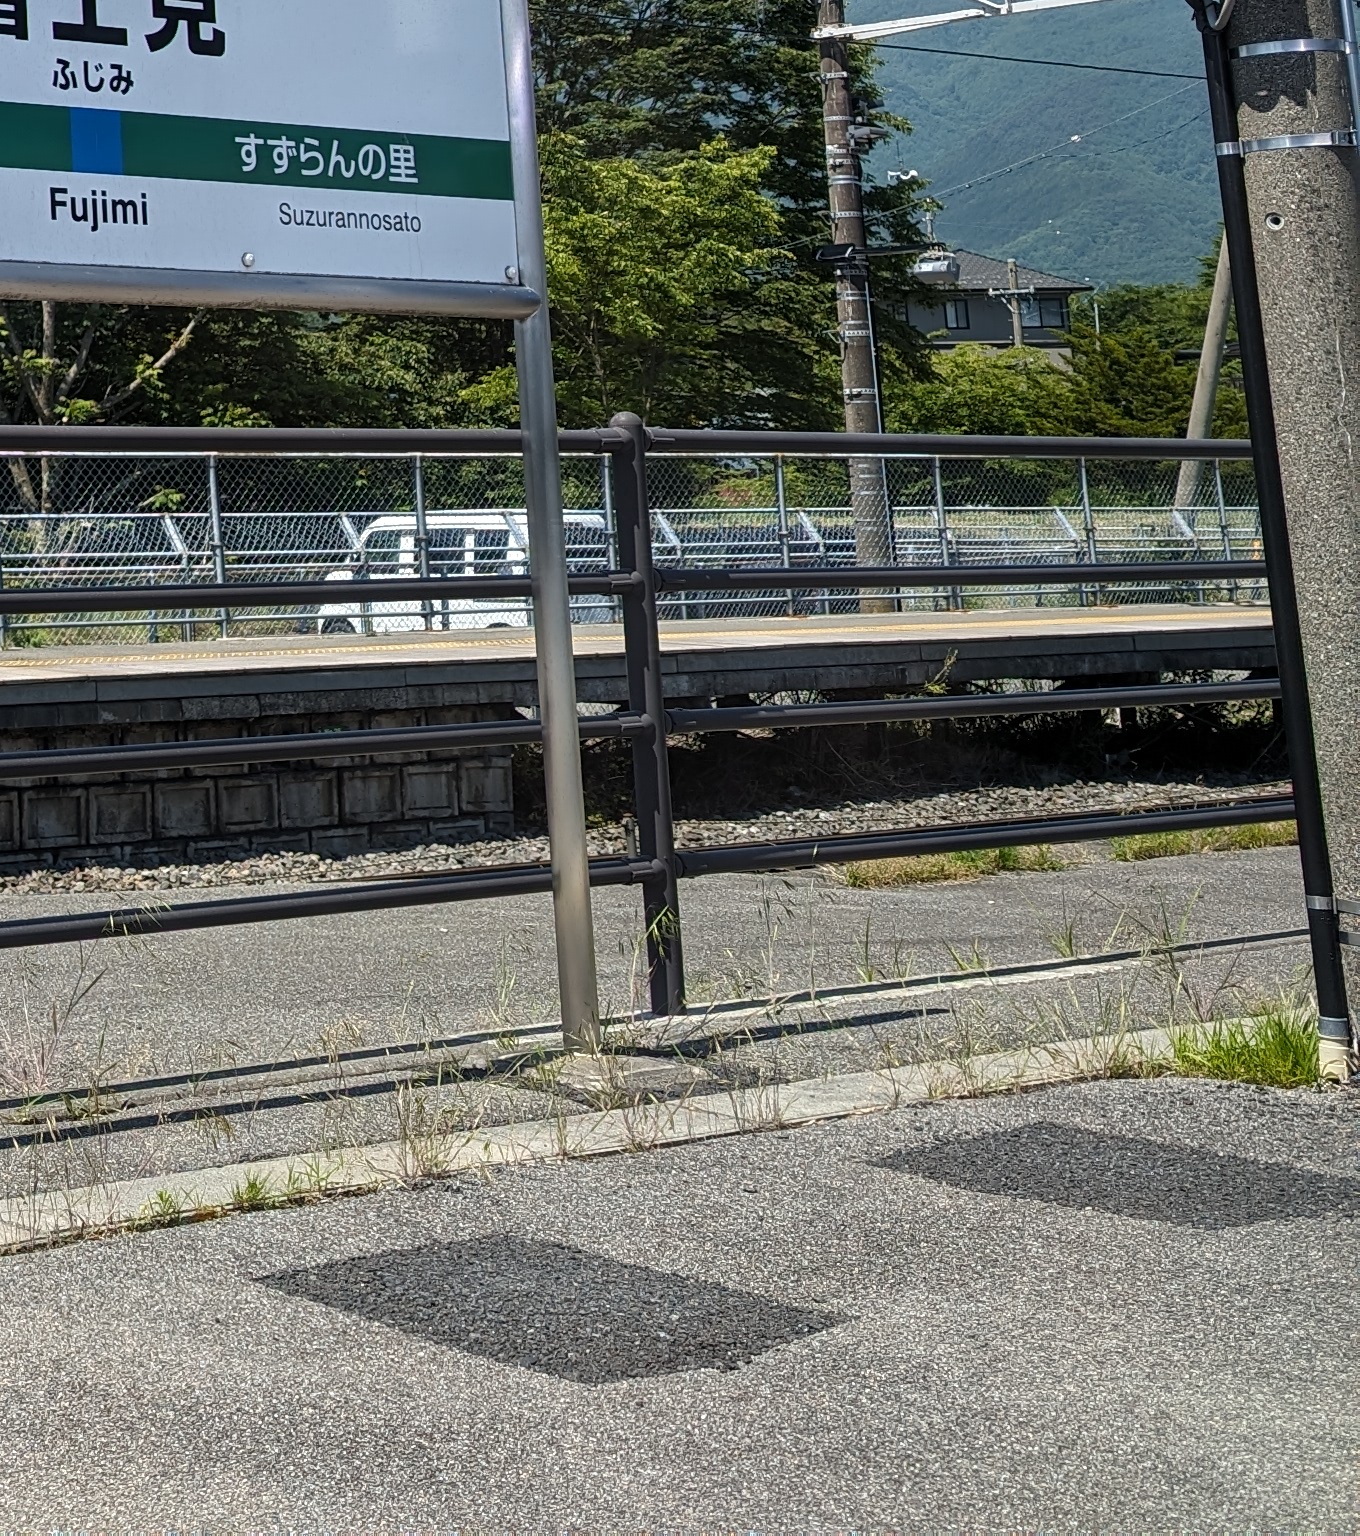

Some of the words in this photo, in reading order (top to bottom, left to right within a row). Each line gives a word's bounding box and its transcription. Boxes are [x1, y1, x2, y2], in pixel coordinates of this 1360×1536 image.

[52, 58, 134, 96] ふじみ
[234, 133, 419, 184] すずらんの里
[48, 186, 149, 232] Fujimi
[278, 202, 422, 233] Suzurannosato
